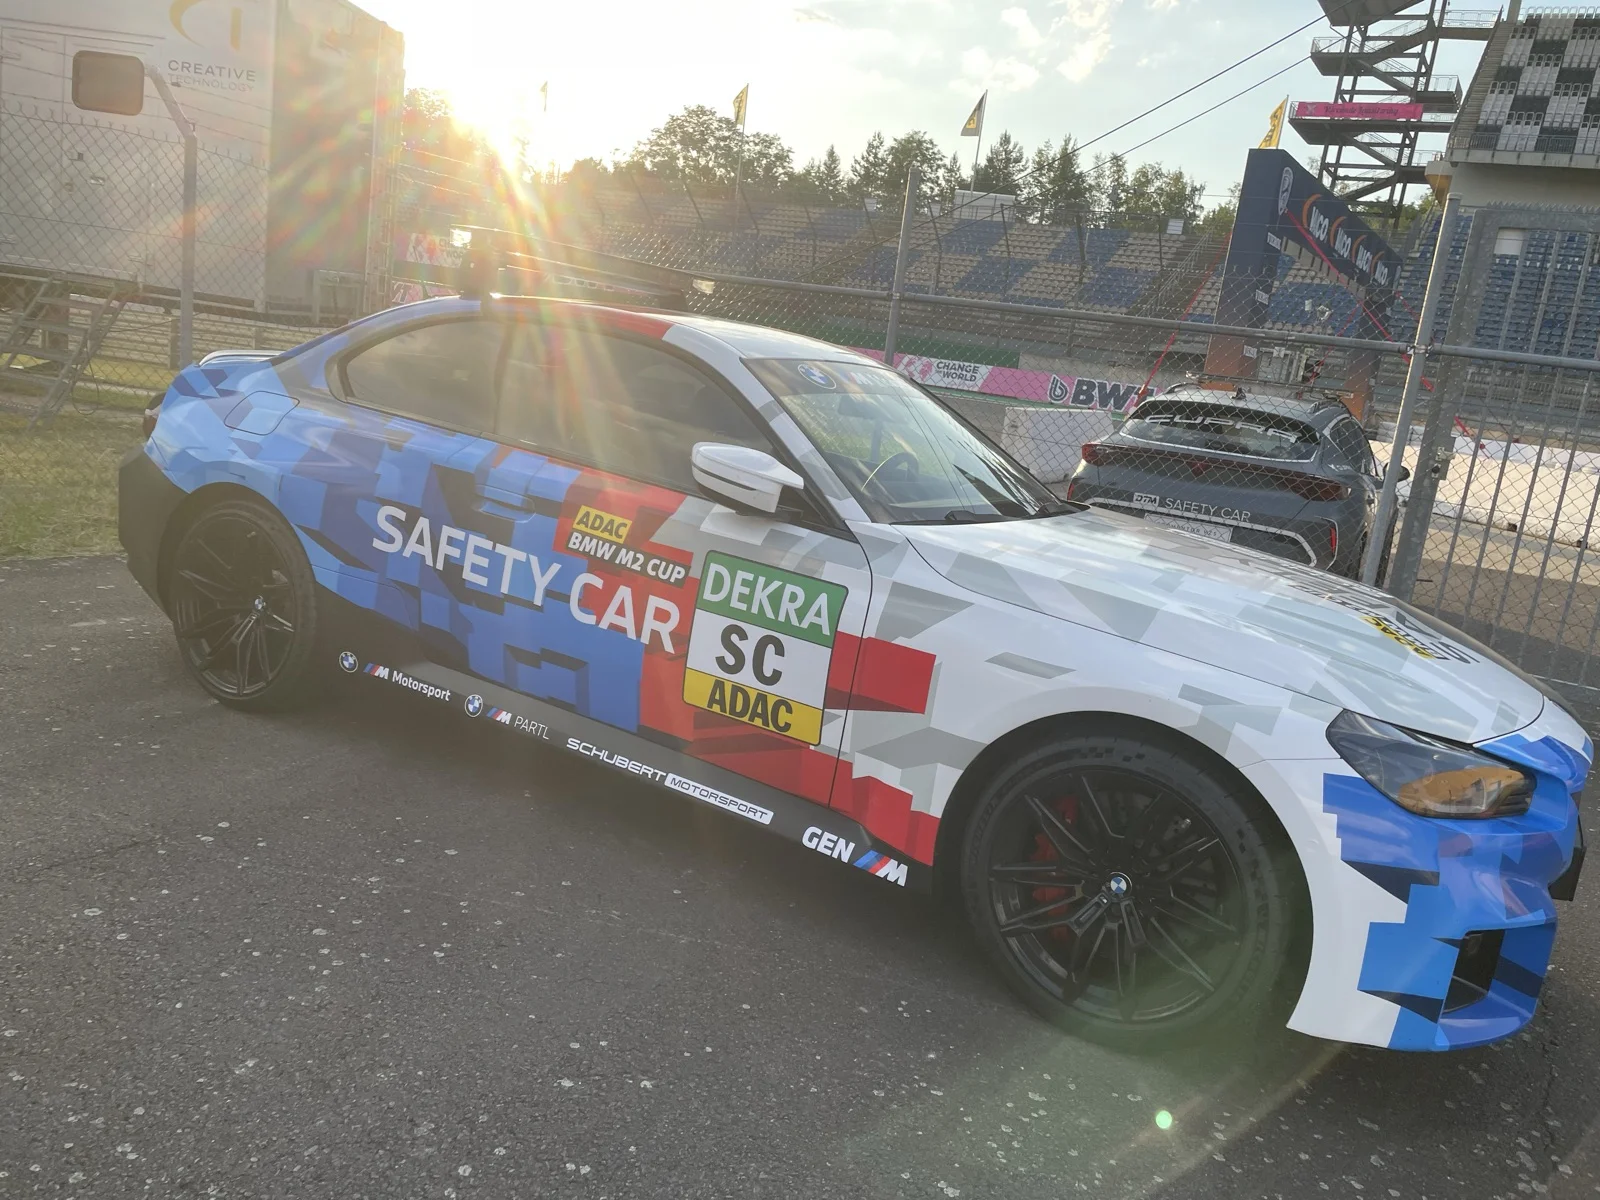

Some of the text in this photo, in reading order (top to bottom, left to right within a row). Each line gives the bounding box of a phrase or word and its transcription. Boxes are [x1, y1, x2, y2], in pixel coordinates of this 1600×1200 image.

[168, 60, 256, 82] CREATIVE
[168, 73, 254, 92] TECHNOLOGY
[936, 361, 980, 374] CHANGE
[942, 371, 977, 382] WORLD
[1145, 414, 1299, 443] CUPRA
[1135, 494, 1251, 522] DTM SAFETY CAR
[576, 511, 628, 539] ADAC
[568, 532, 686, 583] BMW M2 CUP
[372, 505, 680, 655] SAFETY CAR
[703, 563, 830, 636] DEKRA
[715, 624, 785, 686] SC
[392, 670, 451, 702] Motorsport
[707, 678, 793, 733] ADAC
[514, 715, 550, 740] PARTL
[566, 737, 768, 820] SCHUBERT MOTORSPORT
[801, 826, 856, 864] GEN
